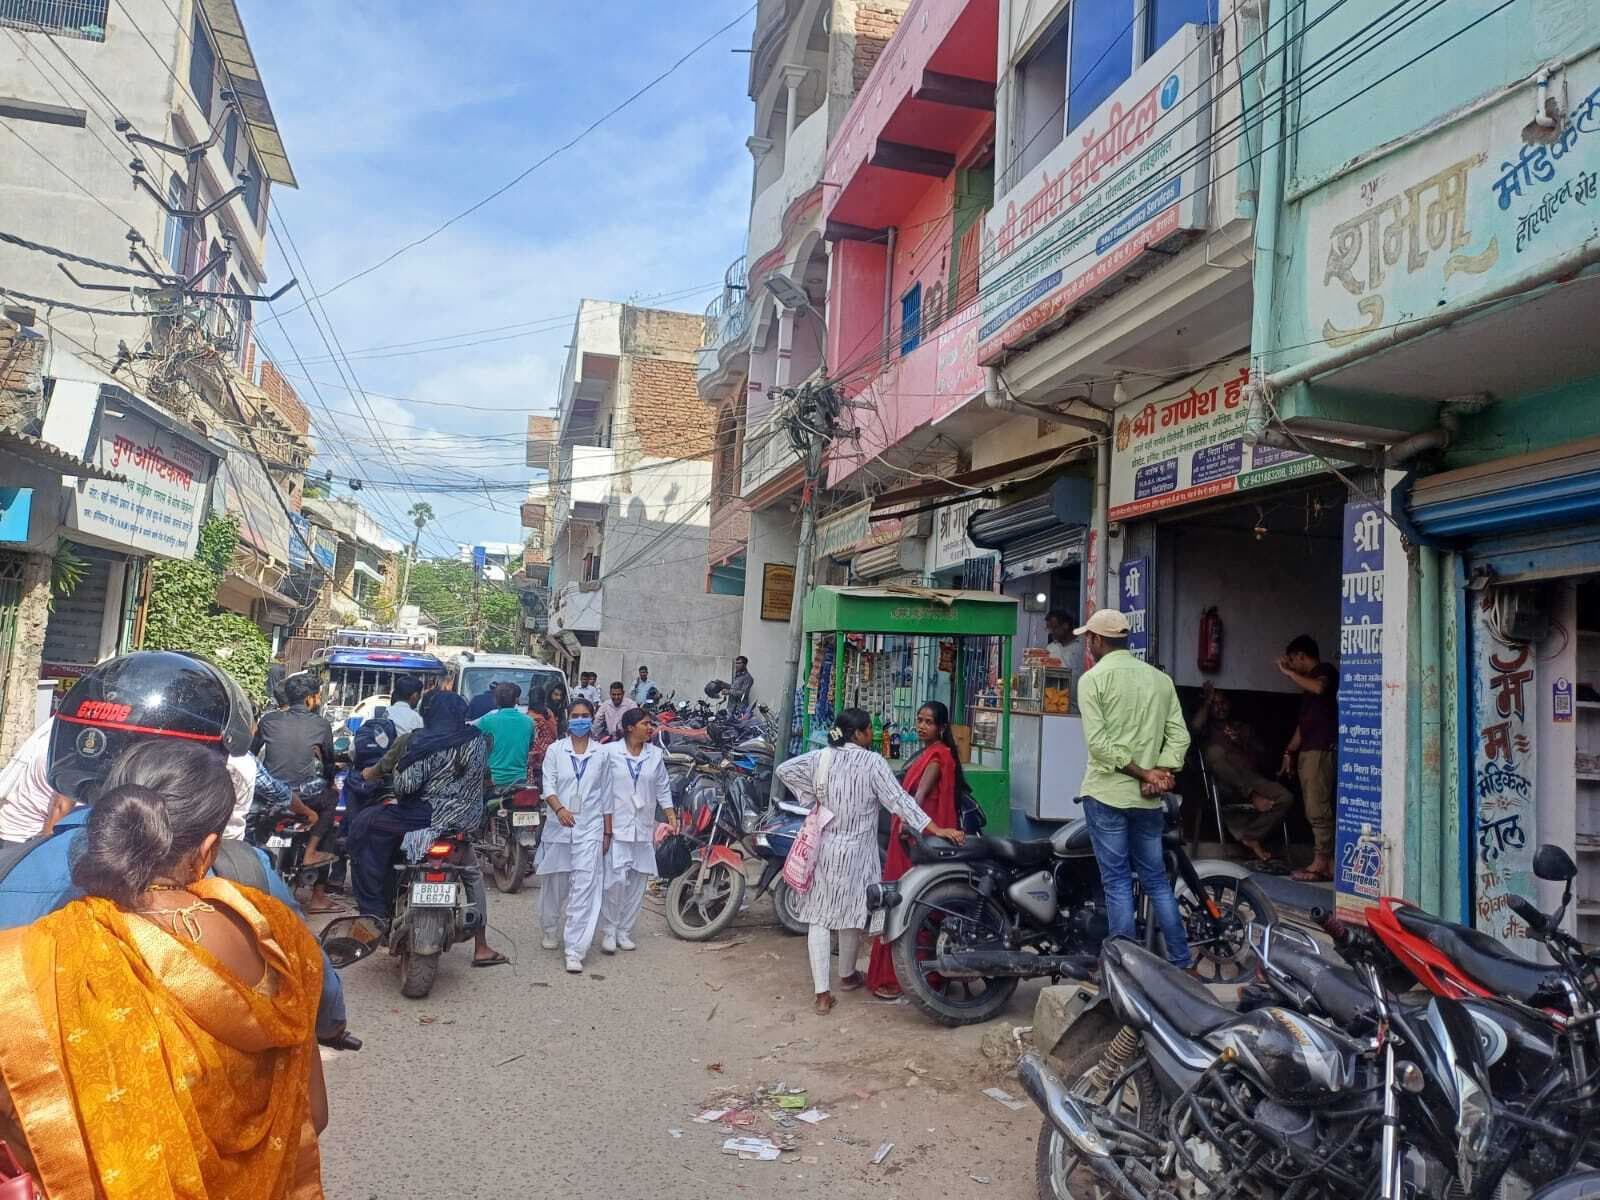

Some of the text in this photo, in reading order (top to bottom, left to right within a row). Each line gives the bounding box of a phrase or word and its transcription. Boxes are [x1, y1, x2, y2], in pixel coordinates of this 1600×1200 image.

[997, 199, 1018, 256] श्री
[1019, 169, 1065, 241] गणेश
[1131, 402, 1157, 439] श्री
[1160, 386, 1219, 427] गणेश
[111, 433, 135, 467] युग
[134, 440, 194, 491] ऑप्टिकल्स
[1353, 510, 1382, 553] श्री
[1125, 567, 1141, 599] श्री
[1477, 760, 1532, 800] मेडिकल
[1478, 811, 1526, 864] हॉल
